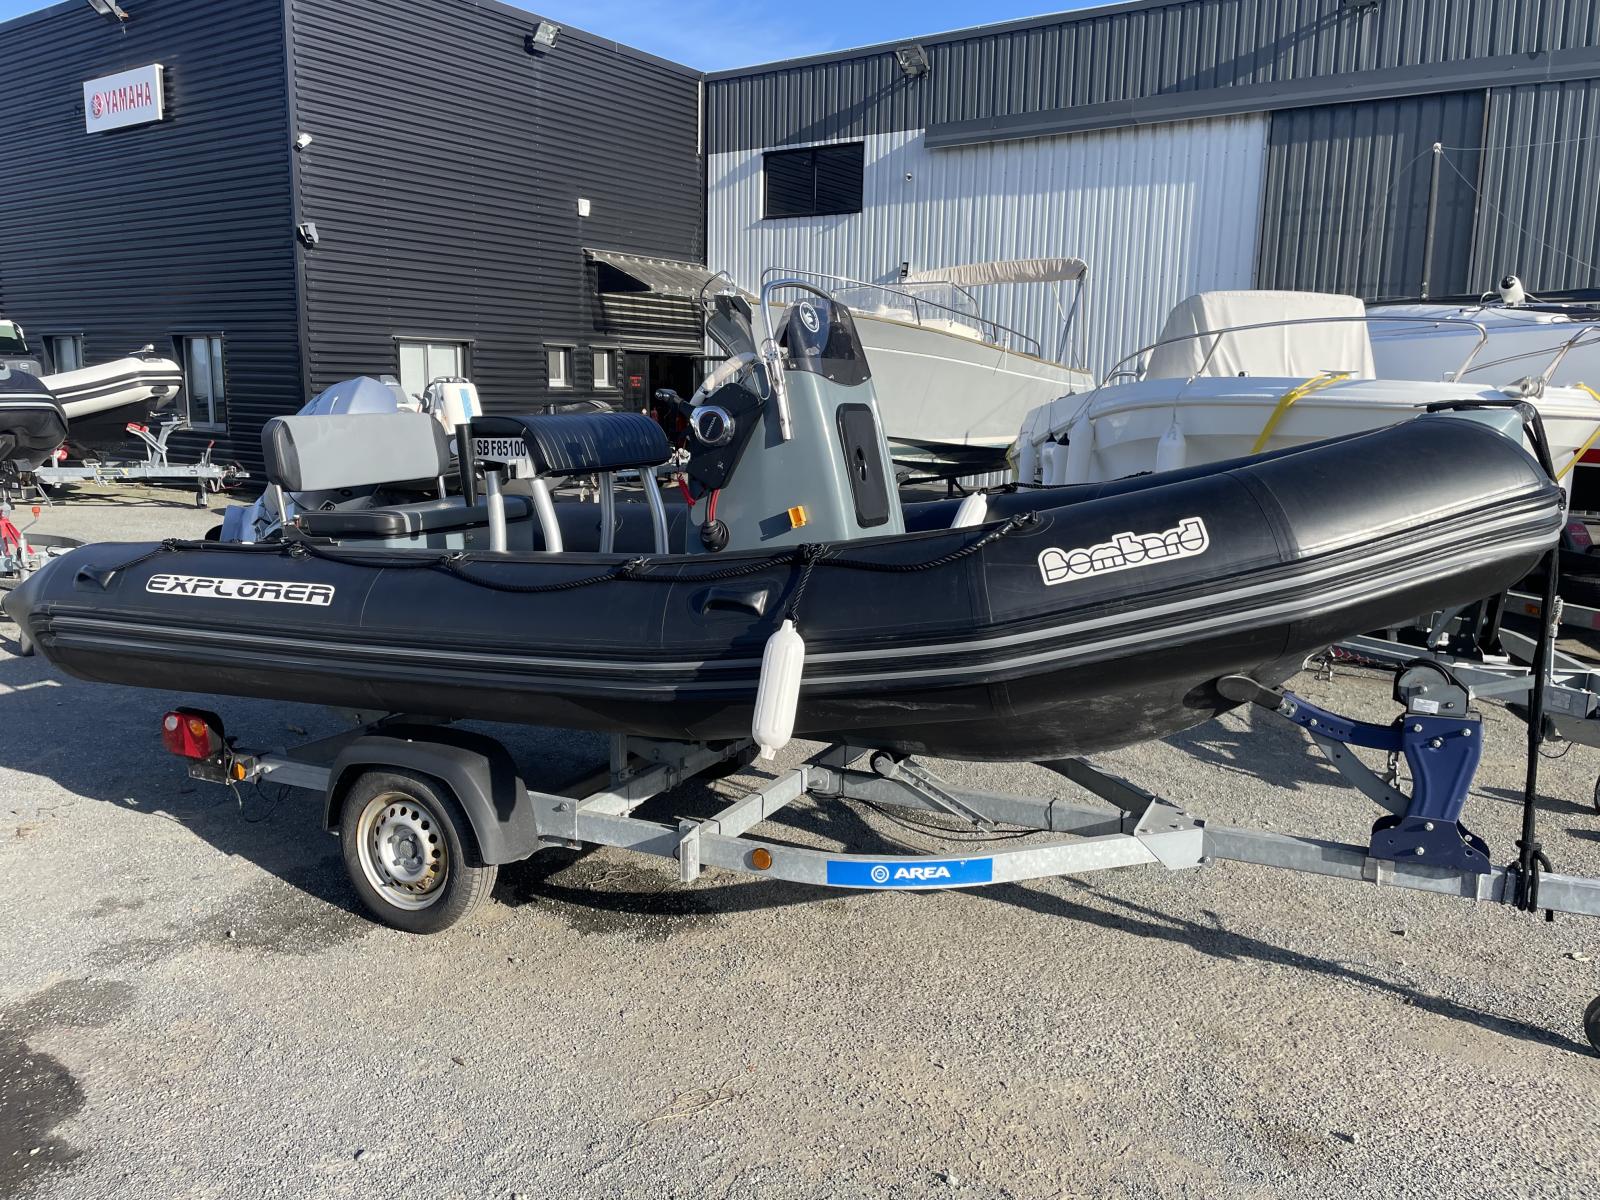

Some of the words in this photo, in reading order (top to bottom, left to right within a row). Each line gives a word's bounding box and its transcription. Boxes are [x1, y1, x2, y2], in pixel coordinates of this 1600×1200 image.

[104, 82, 152, 114] YAMAHA
[1040, 519, 1206, 583] Bombard
[147, 575, 331, 604] EXPLORER
[894, 866, 951, 880] AREA
